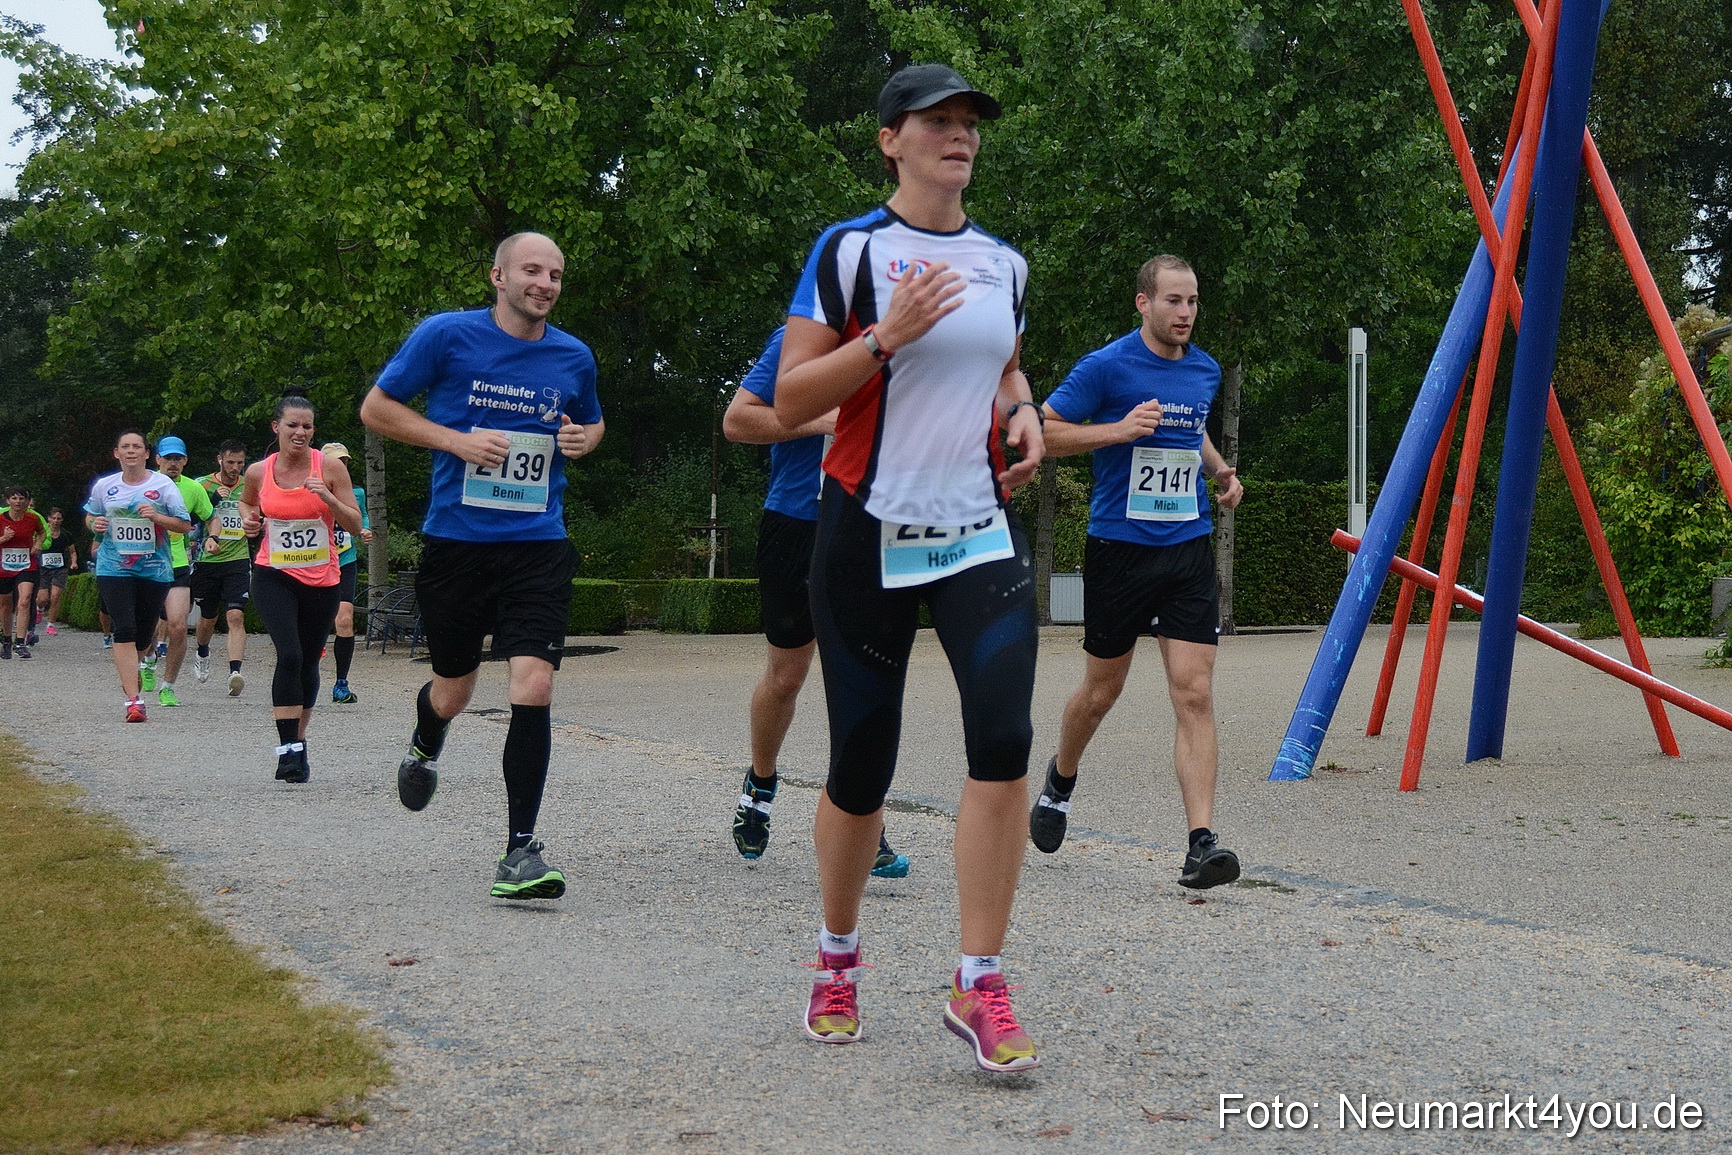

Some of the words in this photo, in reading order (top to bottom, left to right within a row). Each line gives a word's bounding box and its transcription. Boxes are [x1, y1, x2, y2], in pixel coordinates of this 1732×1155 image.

[472, 380, 536, 399] Kirwaläufer
[468, 394, 535, 414] Pettenhofen
[1138, 465, 1191, 493] 2141
[492, 486, 524, 500] Benni
[1154, 500, 1178, 511] Michi
[222, 516, 242, 528] 358
[117, 526, 151, 540] 3003
[281, 529, 317, 549] 352
[5, 553, 28, 563] 2312
[284, 553, 317, 562] Monique
[928, 548, 966, 567] Hana
